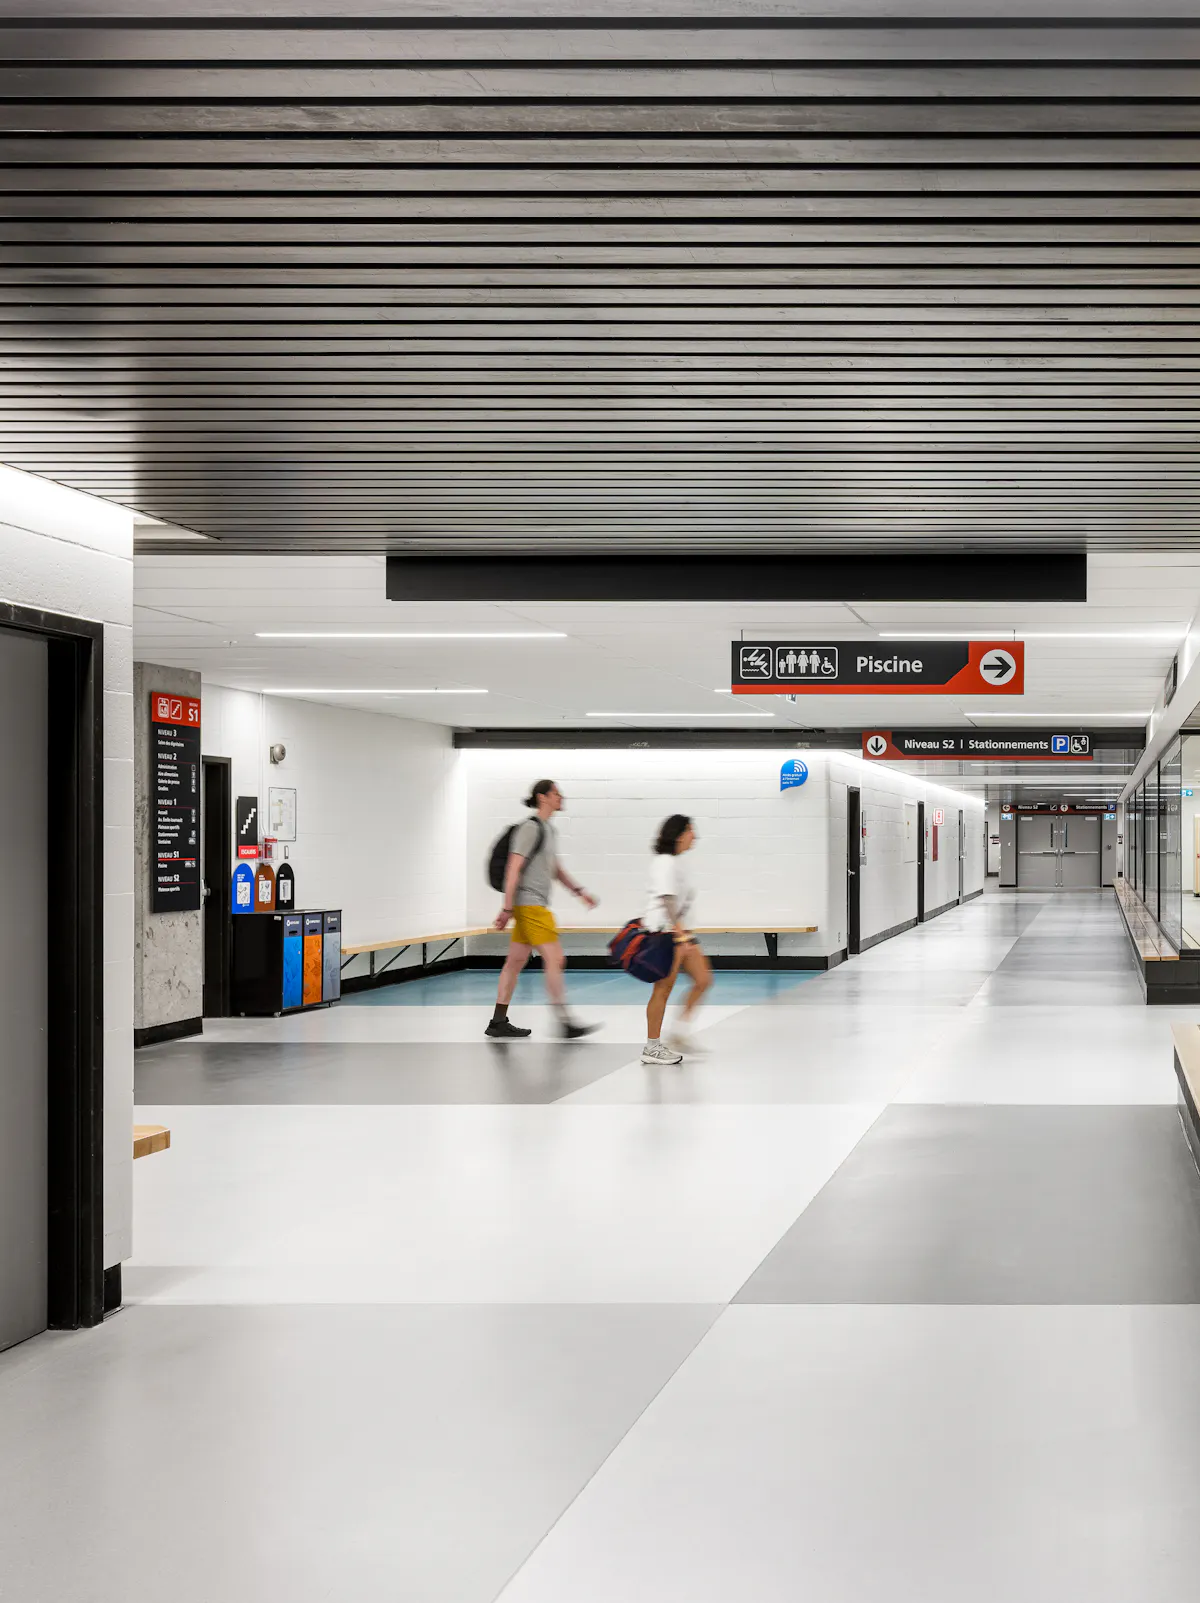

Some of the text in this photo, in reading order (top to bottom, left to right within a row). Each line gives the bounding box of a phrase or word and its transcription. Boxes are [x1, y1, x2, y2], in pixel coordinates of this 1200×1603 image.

[857, 655, 923, 673] Piscine
[188, 708, 198, 722] S1
[173, 729, 177, 737] 3
[904, 739, 940, 749] Niveau
[942, 739, 955, 749] S2
[968, 739, 1049, 749] Stationnements
[173, 752, 177, 760] 2
[173, 874, 180, 882] S2
